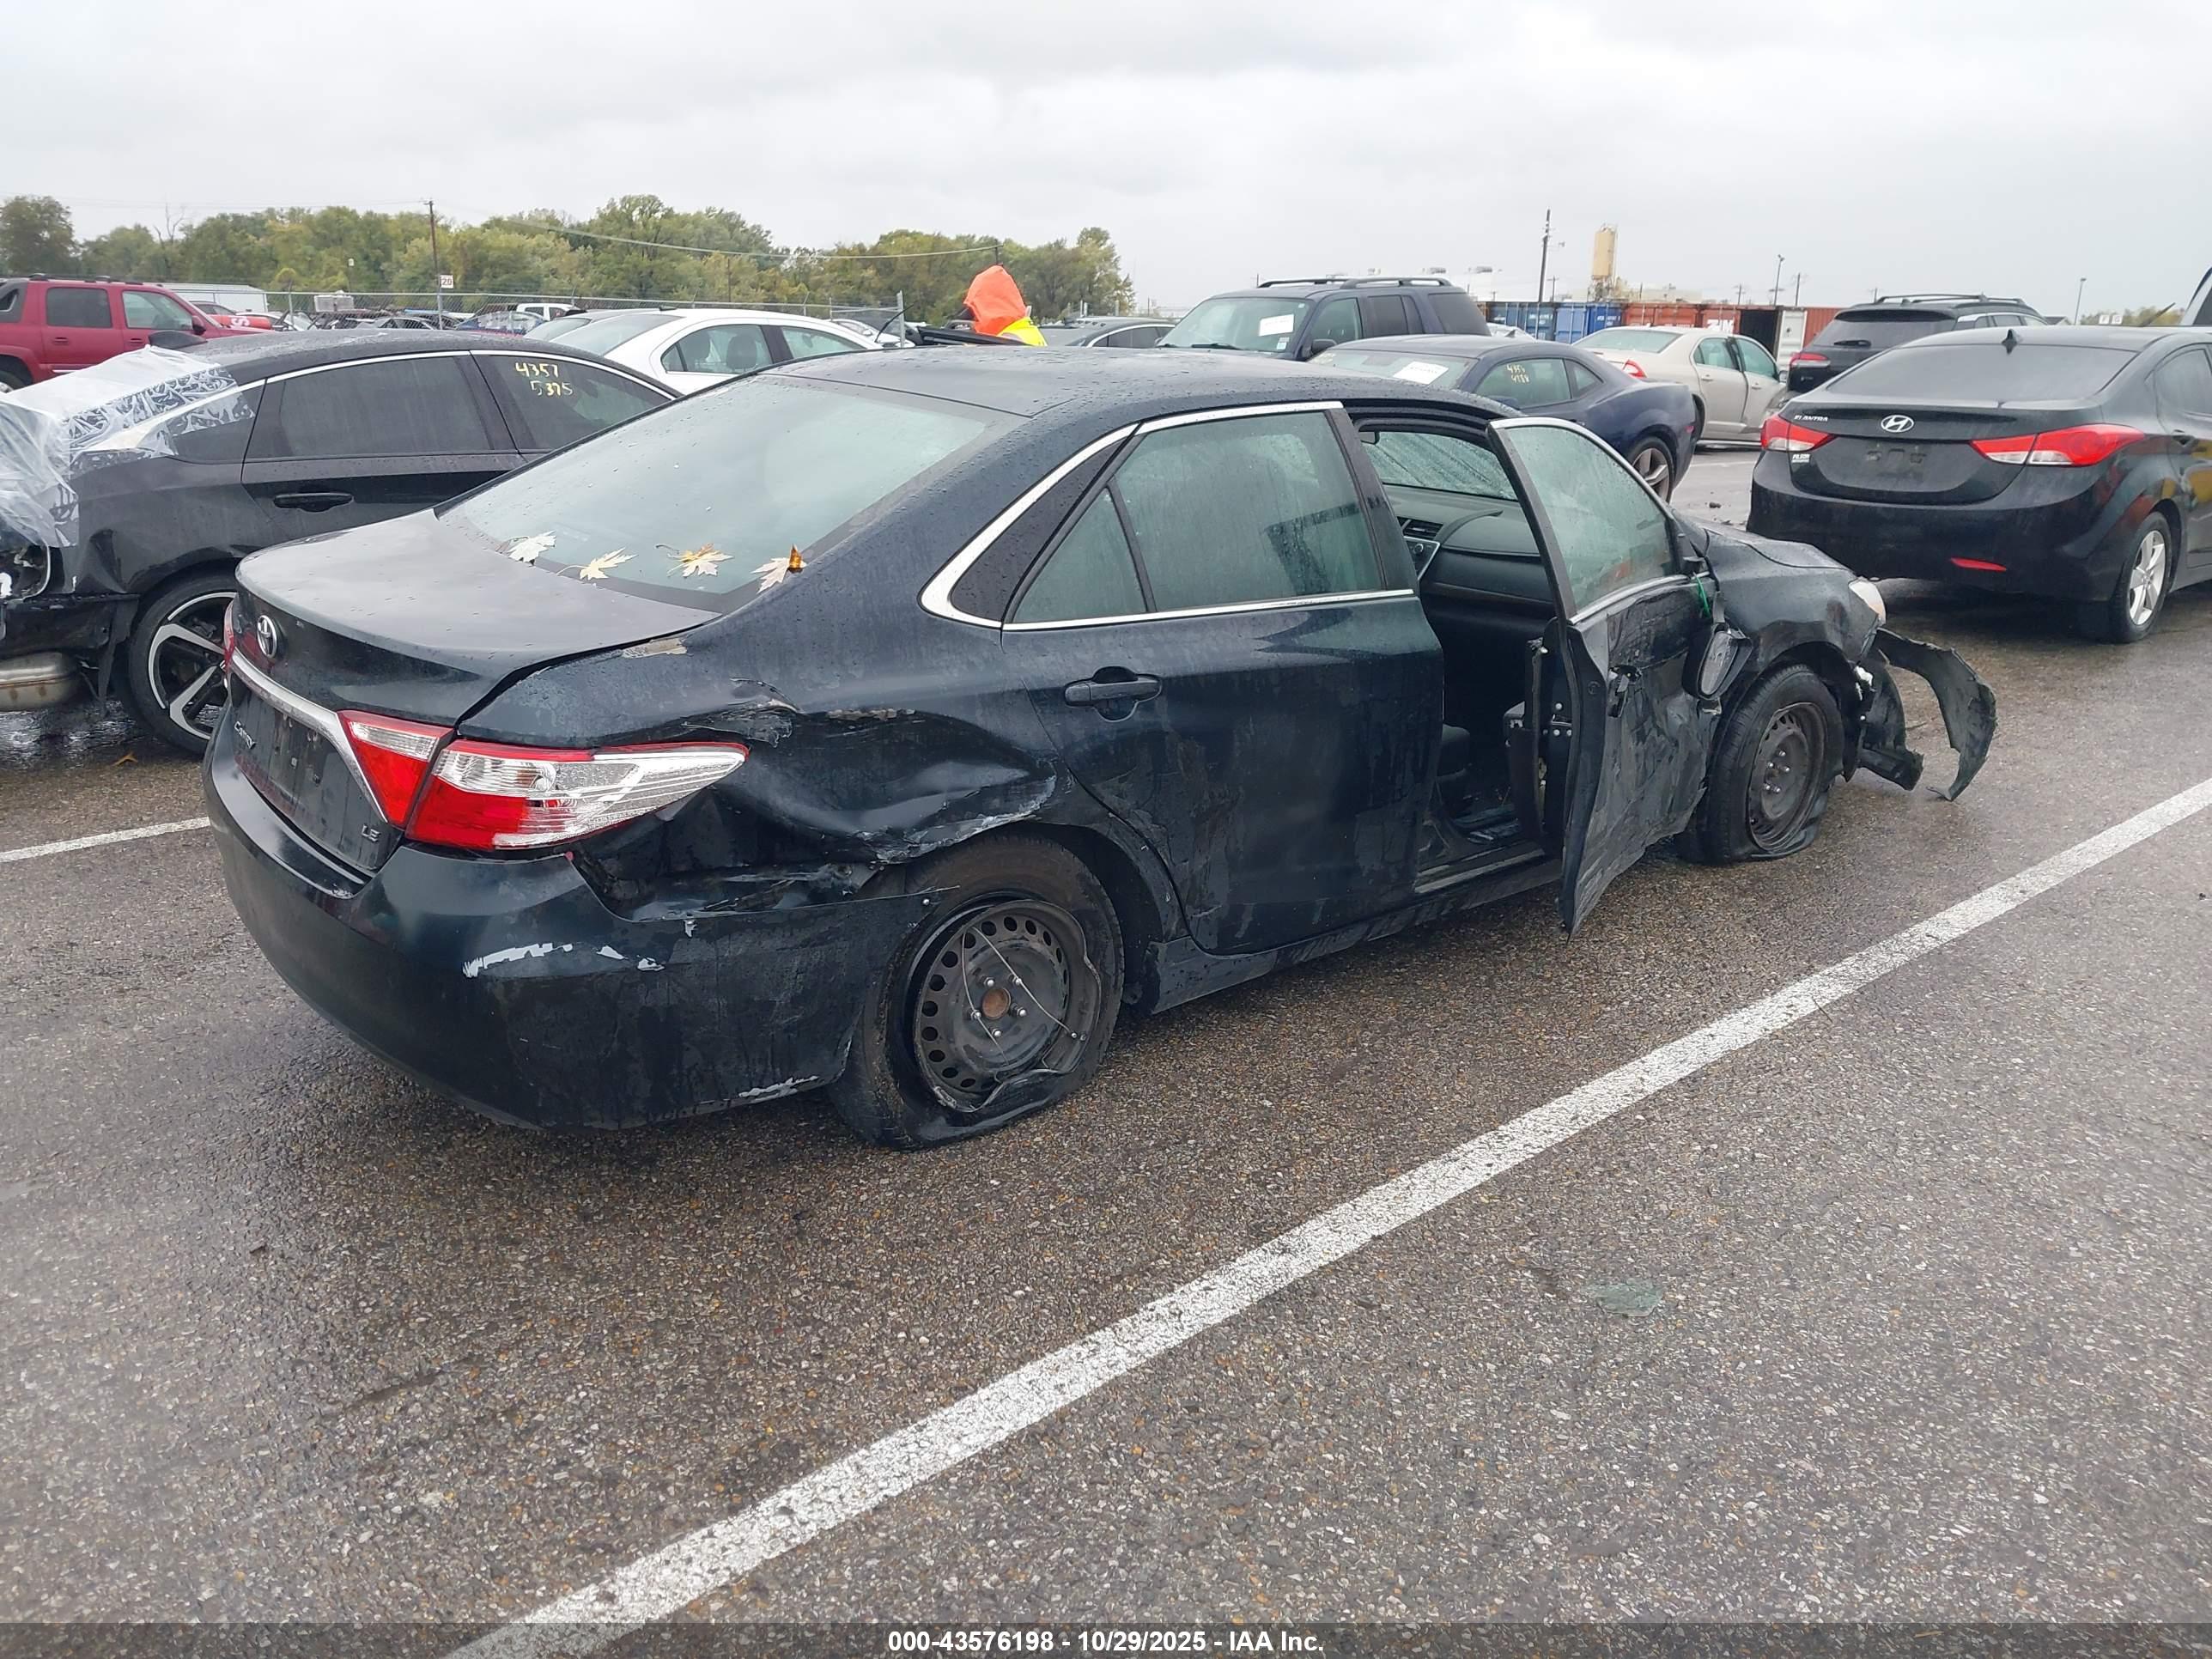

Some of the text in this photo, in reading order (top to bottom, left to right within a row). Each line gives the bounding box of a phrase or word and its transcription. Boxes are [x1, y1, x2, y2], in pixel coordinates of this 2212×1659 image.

[515, 362, 559, 378] 4357
[530, 380, 574, 396] 5375
[361, 824, 380, 842] LE
